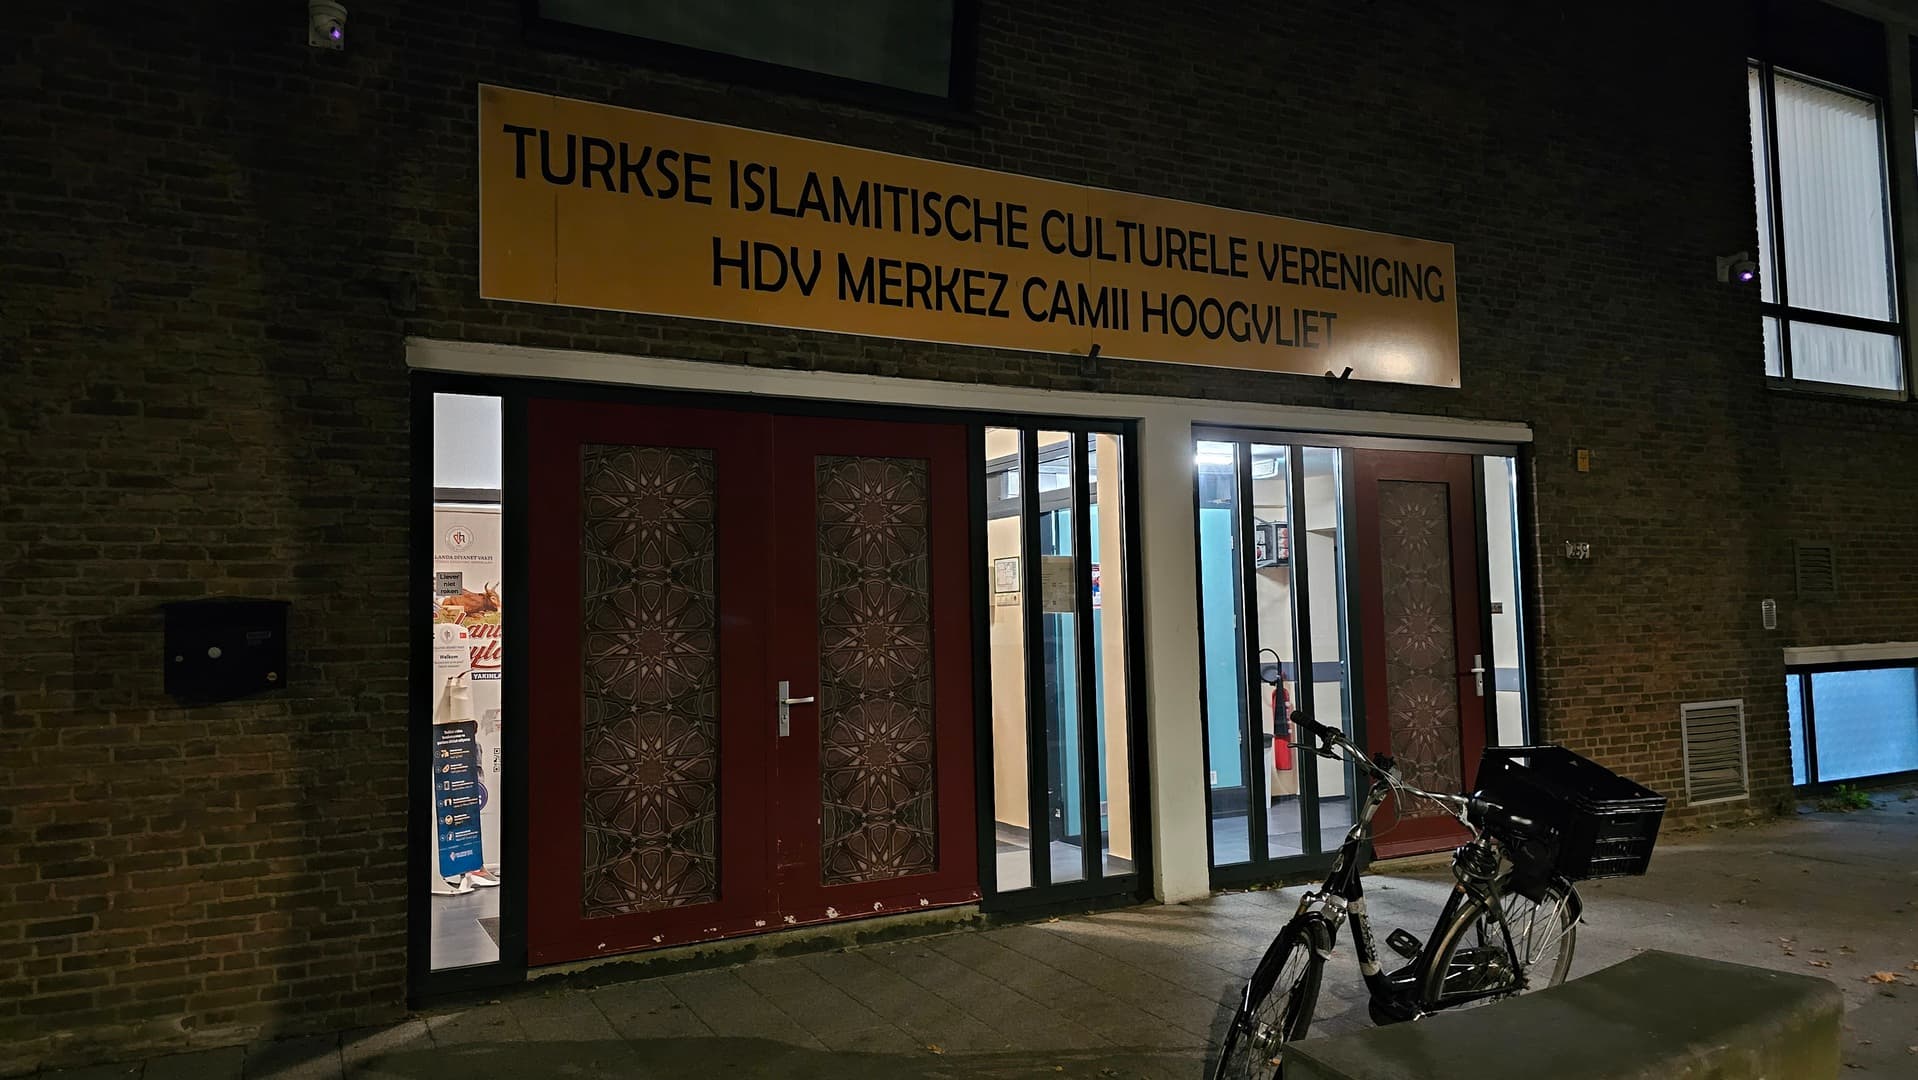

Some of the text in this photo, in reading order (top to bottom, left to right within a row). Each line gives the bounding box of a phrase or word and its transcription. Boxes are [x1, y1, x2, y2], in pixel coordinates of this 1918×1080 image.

[503, 124, 1445, 303] TURKSE ISLAMITISCHE CULTURELE VERENIGING
[712, 236, 1337, 350] HDV MERKEZ CAMII HOOGVLIET
